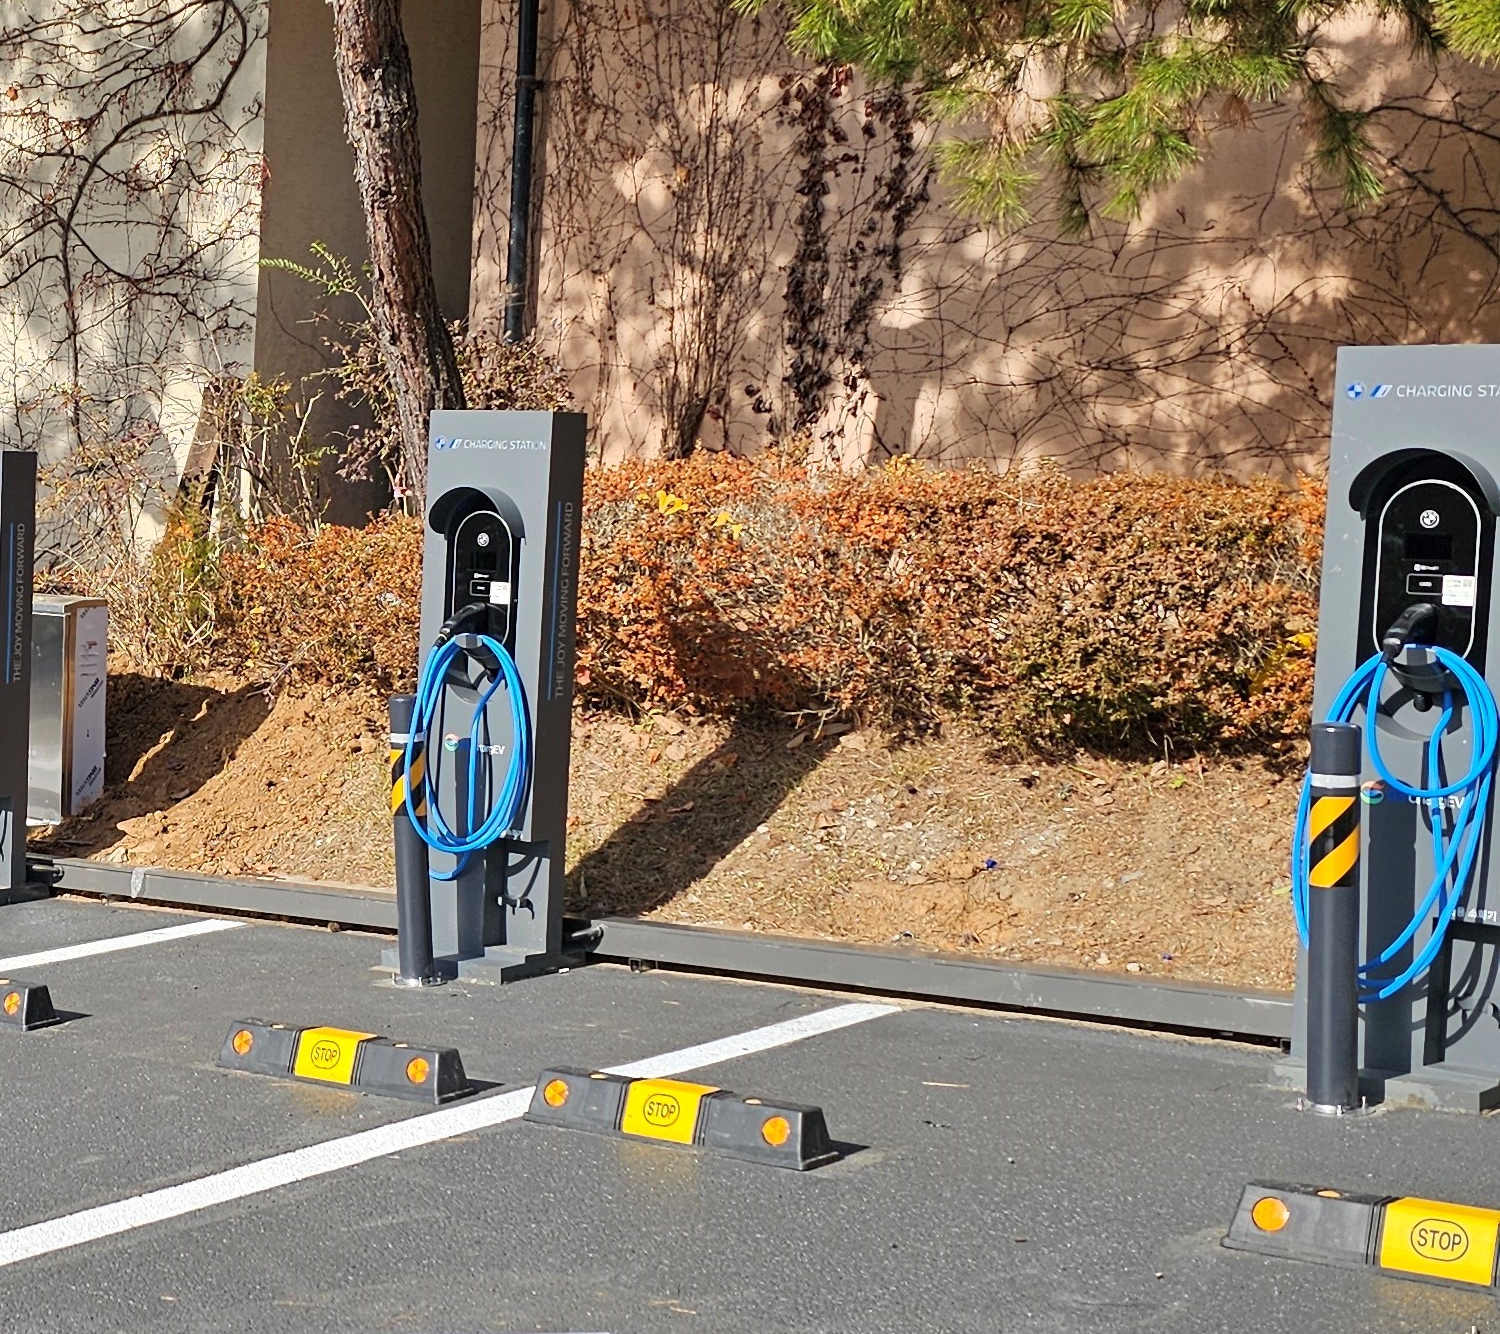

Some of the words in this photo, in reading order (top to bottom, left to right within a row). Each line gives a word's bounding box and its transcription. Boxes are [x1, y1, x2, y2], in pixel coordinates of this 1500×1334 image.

[1396, 384, 1473, 398] CHARGING
[463, 439, 508, 450] CHARGING
[509, 440, 547, 451] STATION
[561, 501, 573, 576] FORWARD
[16, 523, 25, 583] FORWARD
[14, 585, 24, 634] MOVING
[558, 578, 569, 638] MOVING
[13, 635, 22, 658] JOY
[556, 640, 566, 668] JOY
[13, 660, 21, 683] THE
[555, 670, 564, 699] THE
[314, 1047, 338, 1063] STOP
[647, 1101, 676, 1119] STOP
[1417, 1228, 1462, 1252] STOP
